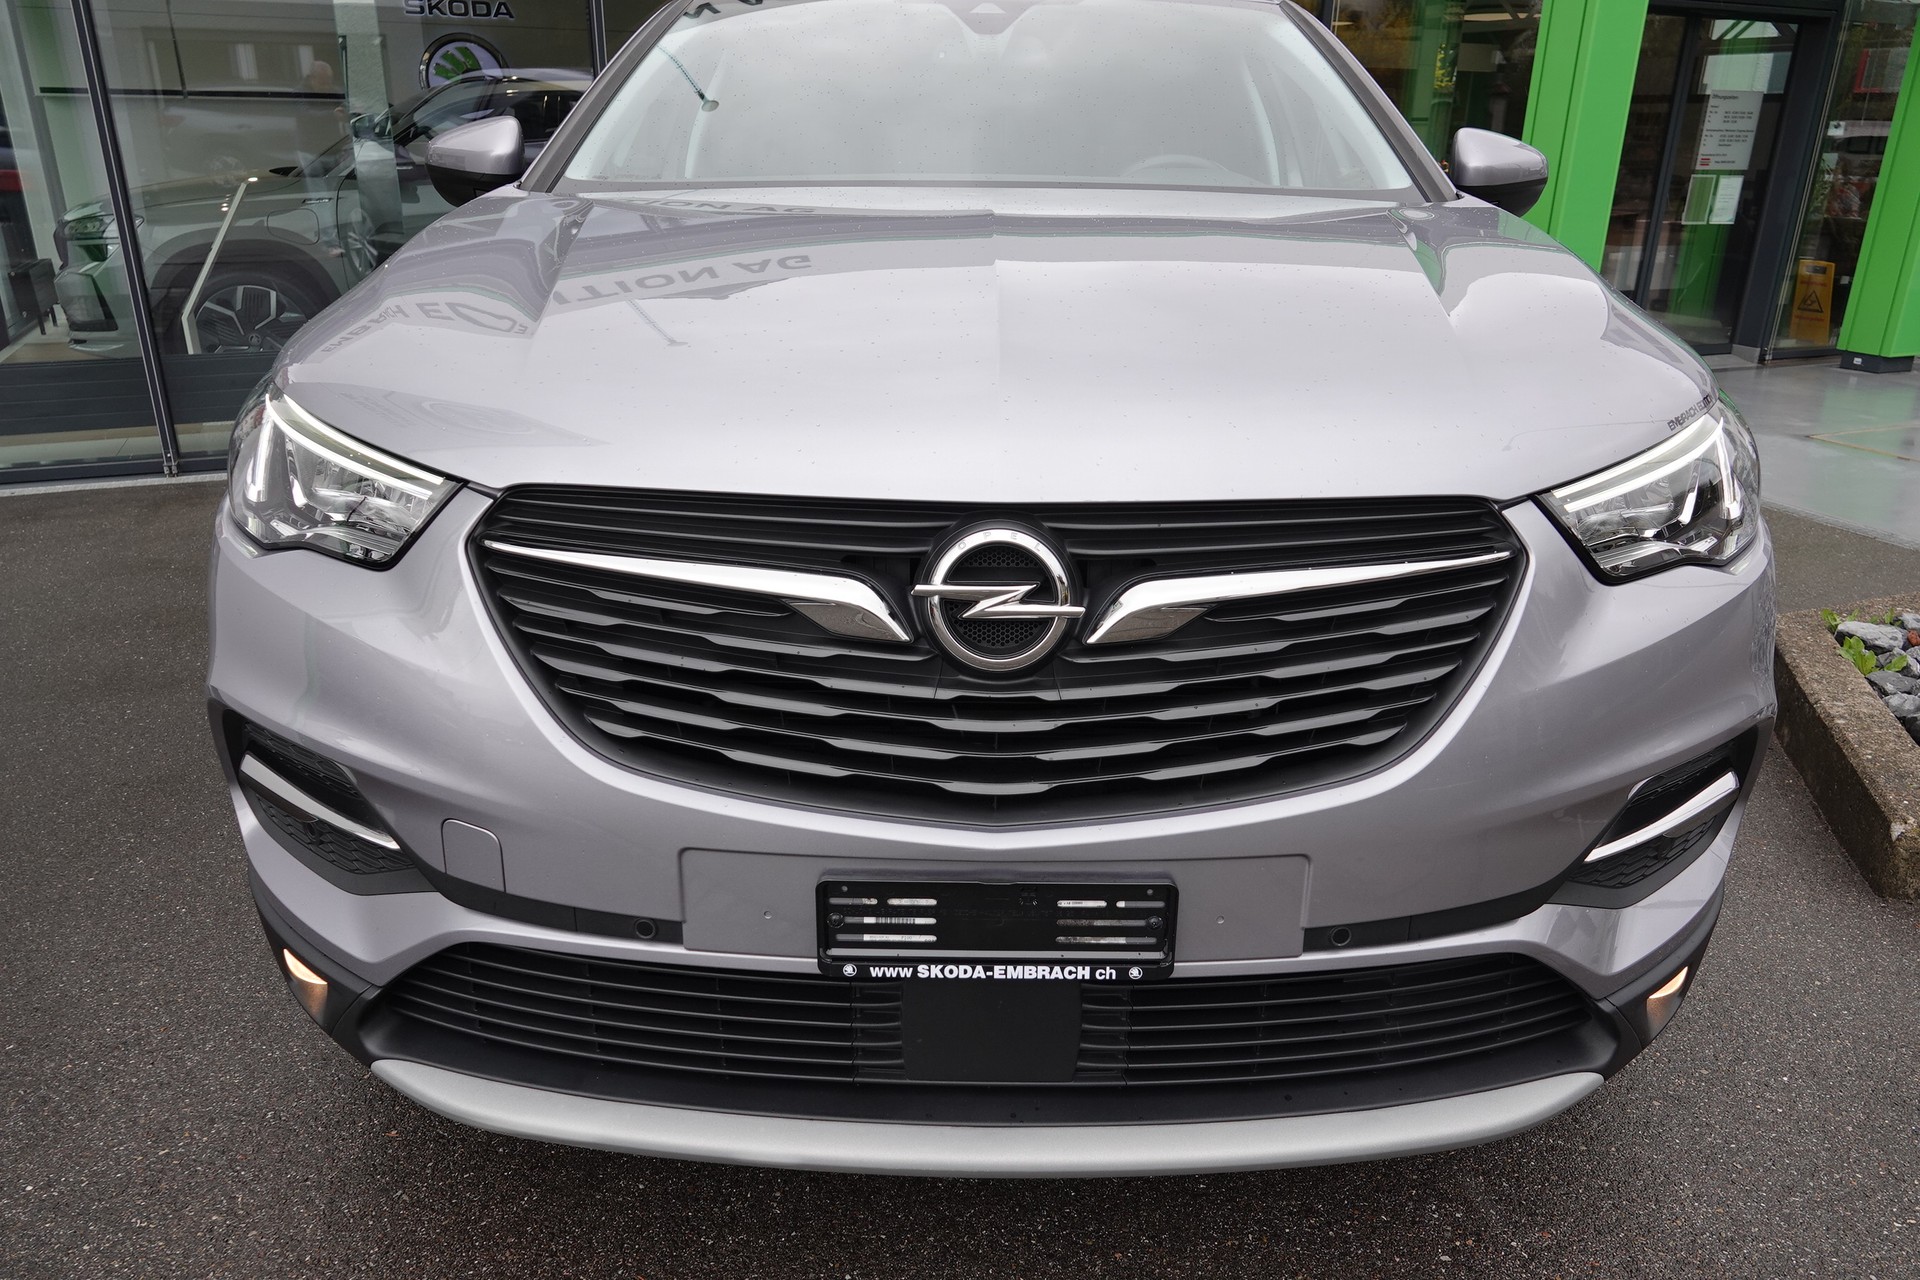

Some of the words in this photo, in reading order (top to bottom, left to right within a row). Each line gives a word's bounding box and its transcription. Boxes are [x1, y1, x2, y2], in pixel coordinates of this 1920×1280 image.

[957, 531, 1041, 552] OPEL
[870, 965, 913, 978] www
[917, 964, 1090, 980] SKODA-EMBRACH
[1095, 967, 1116, 980] ch
